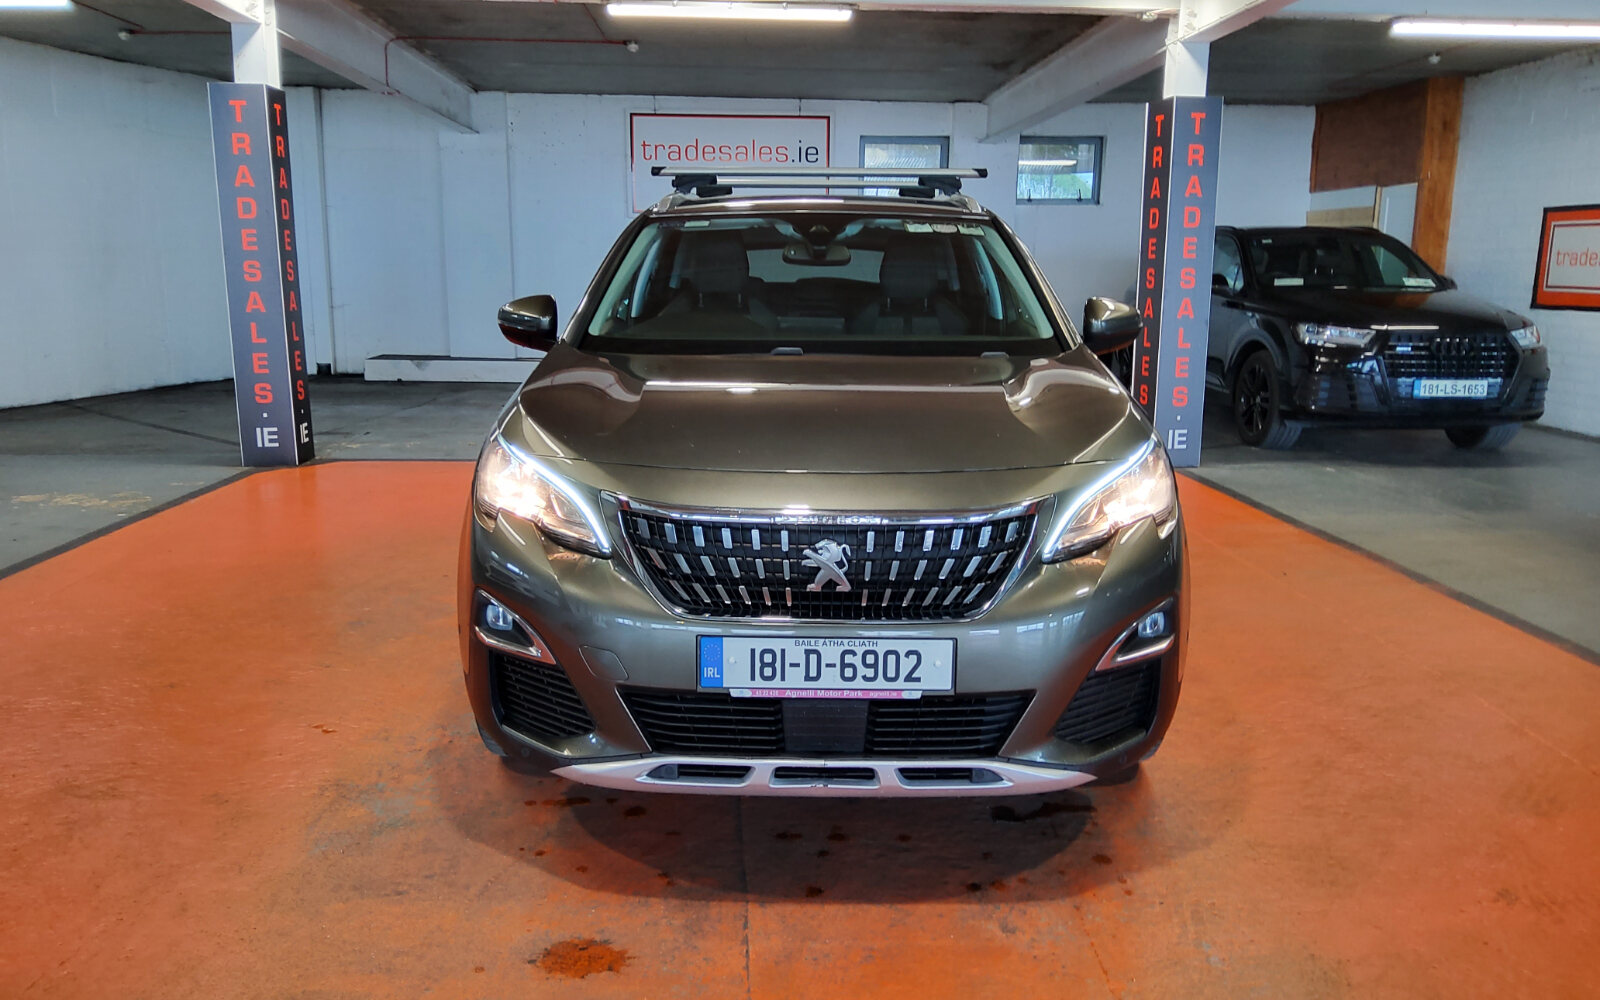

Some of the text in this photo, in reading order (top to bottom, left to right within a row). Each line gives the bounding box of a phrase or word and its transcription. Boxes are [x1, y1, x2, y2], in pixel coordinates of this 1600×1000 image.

[640, 138, 819, 163] tradesales.ie
[1555, 248, 1600, 267] trade
[1422, 383, 1486, 395] 181-LS-1653
[822, 637, 845, 647] ÁTHA
[749, 648, 922, 683] 181-D-6902
[703, 667, 721, 679] IRL
[785, 689, 815, 698] Agnelli
